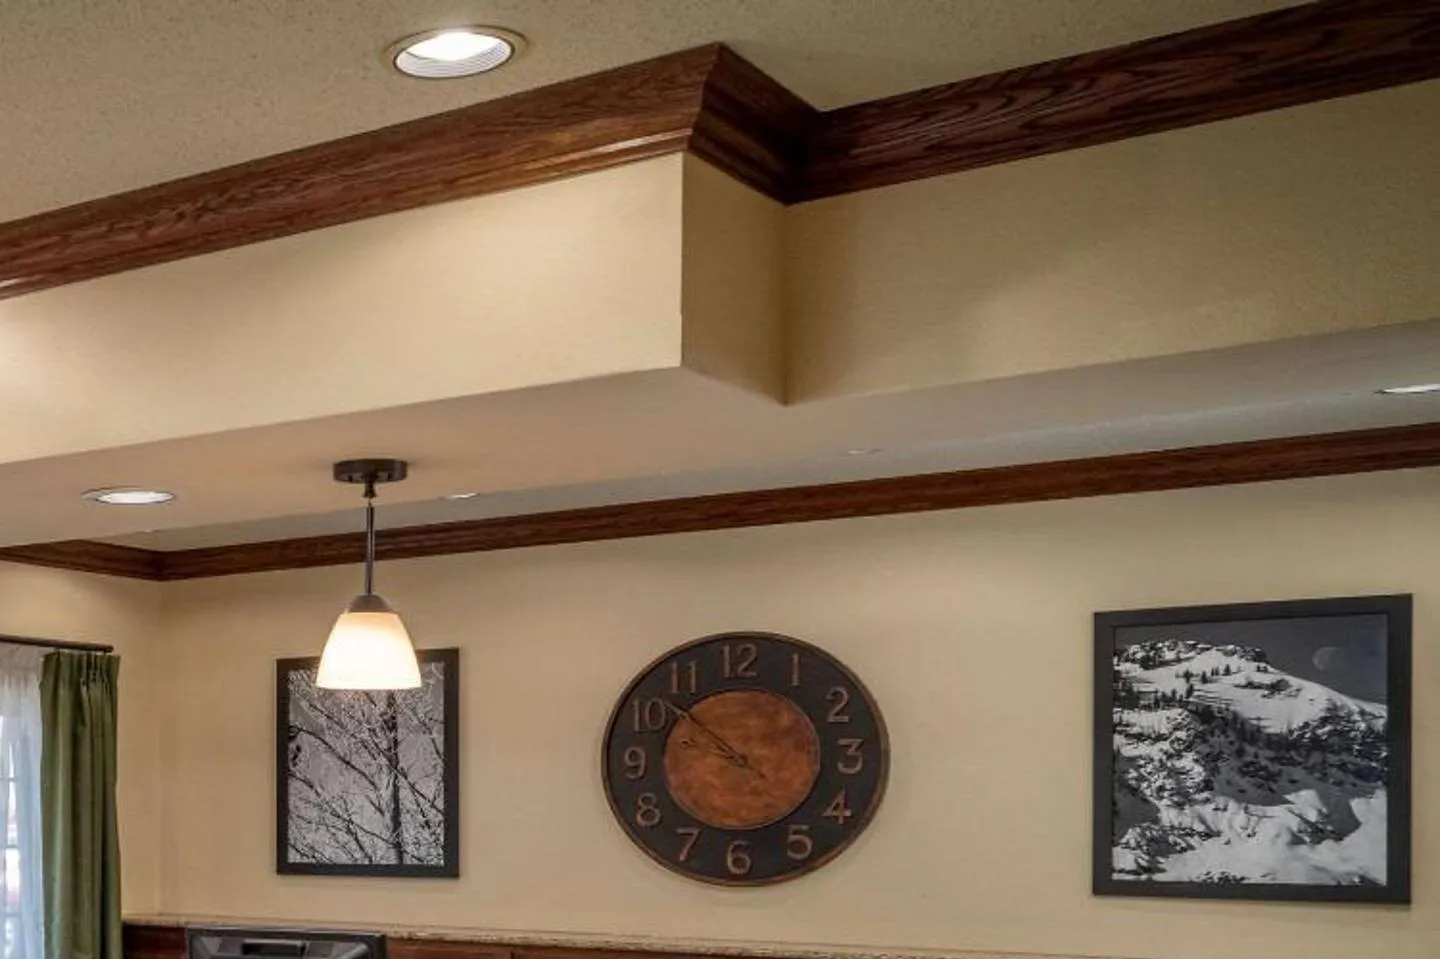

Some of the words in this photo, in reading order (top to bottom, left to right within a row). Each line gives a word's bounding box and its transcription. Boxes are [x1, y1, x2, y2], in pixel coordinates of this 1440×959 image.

[670, 660, 697, 695] 11
[723, 644, 758, 679] 12
[791, 652, 803, 686] 1
[631, 699, 667, 733] 10
[826, 687, 850, 723] 2
[623, 747, 647, 780] 9
[837, 738, 863, 775] 3
[636, 793, 661, 827] 8
[822, 790, 852, 825] 4
[676, 827, 702, 861] 7
[726, 840, 752, 875] 6
[786, 825, 812, 860] 5
